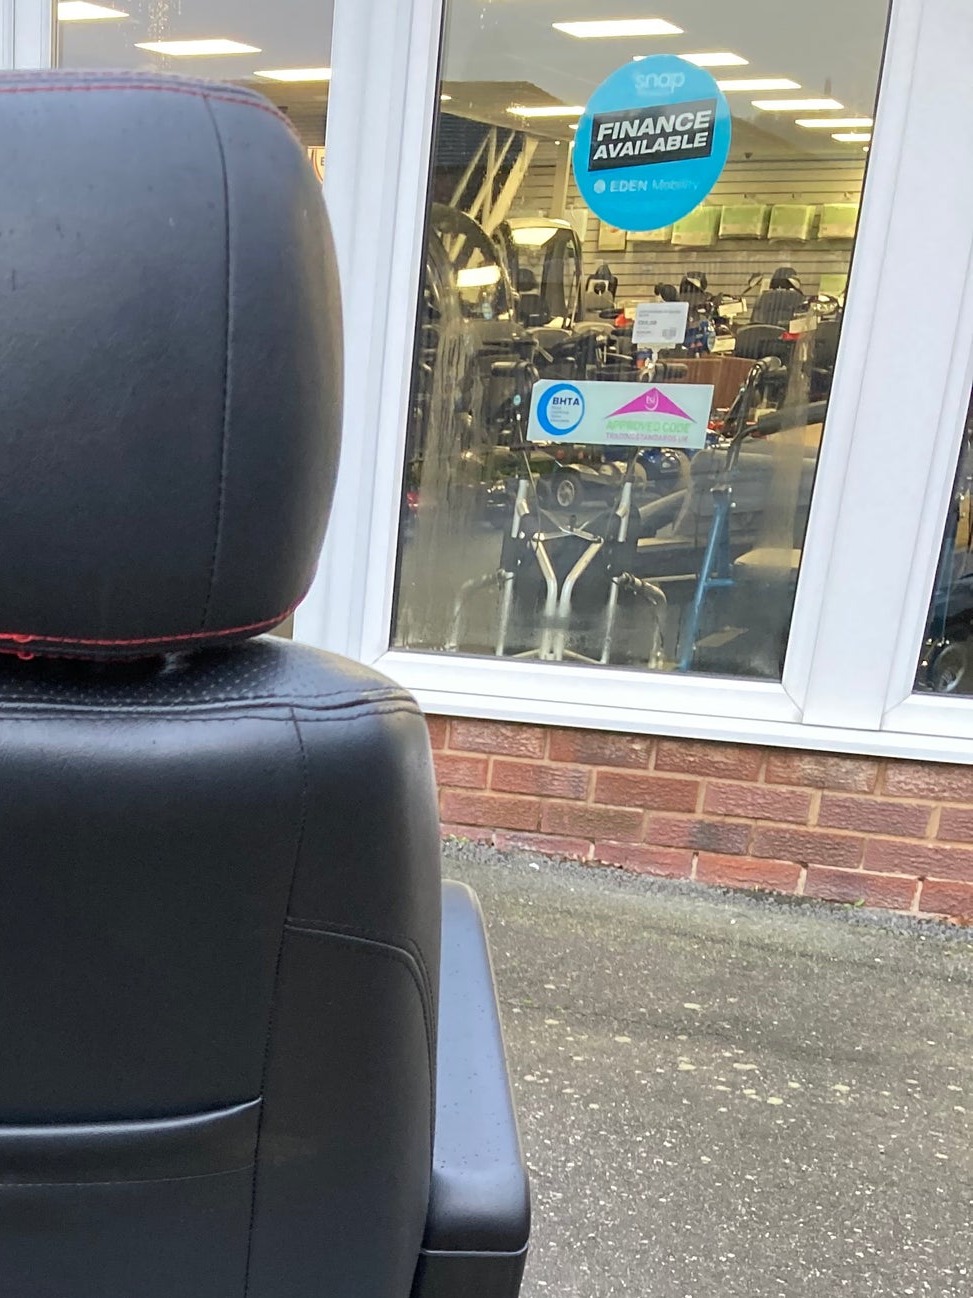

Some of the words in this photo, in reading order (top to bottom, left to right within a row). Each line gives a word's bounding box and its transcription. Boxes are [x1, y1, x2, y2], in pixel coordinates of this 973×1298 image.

[635, 72, 685, 93] snap
[597, 110, 712, 141] FINANCE
[593, 132, 708, 160] AVAILABLE
[610, 179, 648, 193] EDEN
[652, 178, 699, 191] Mobility
[552, 396, 580, 407] BHTA
[606, 420, 661, 433] APPROVED
[663, 422, 691, 434] CODE
